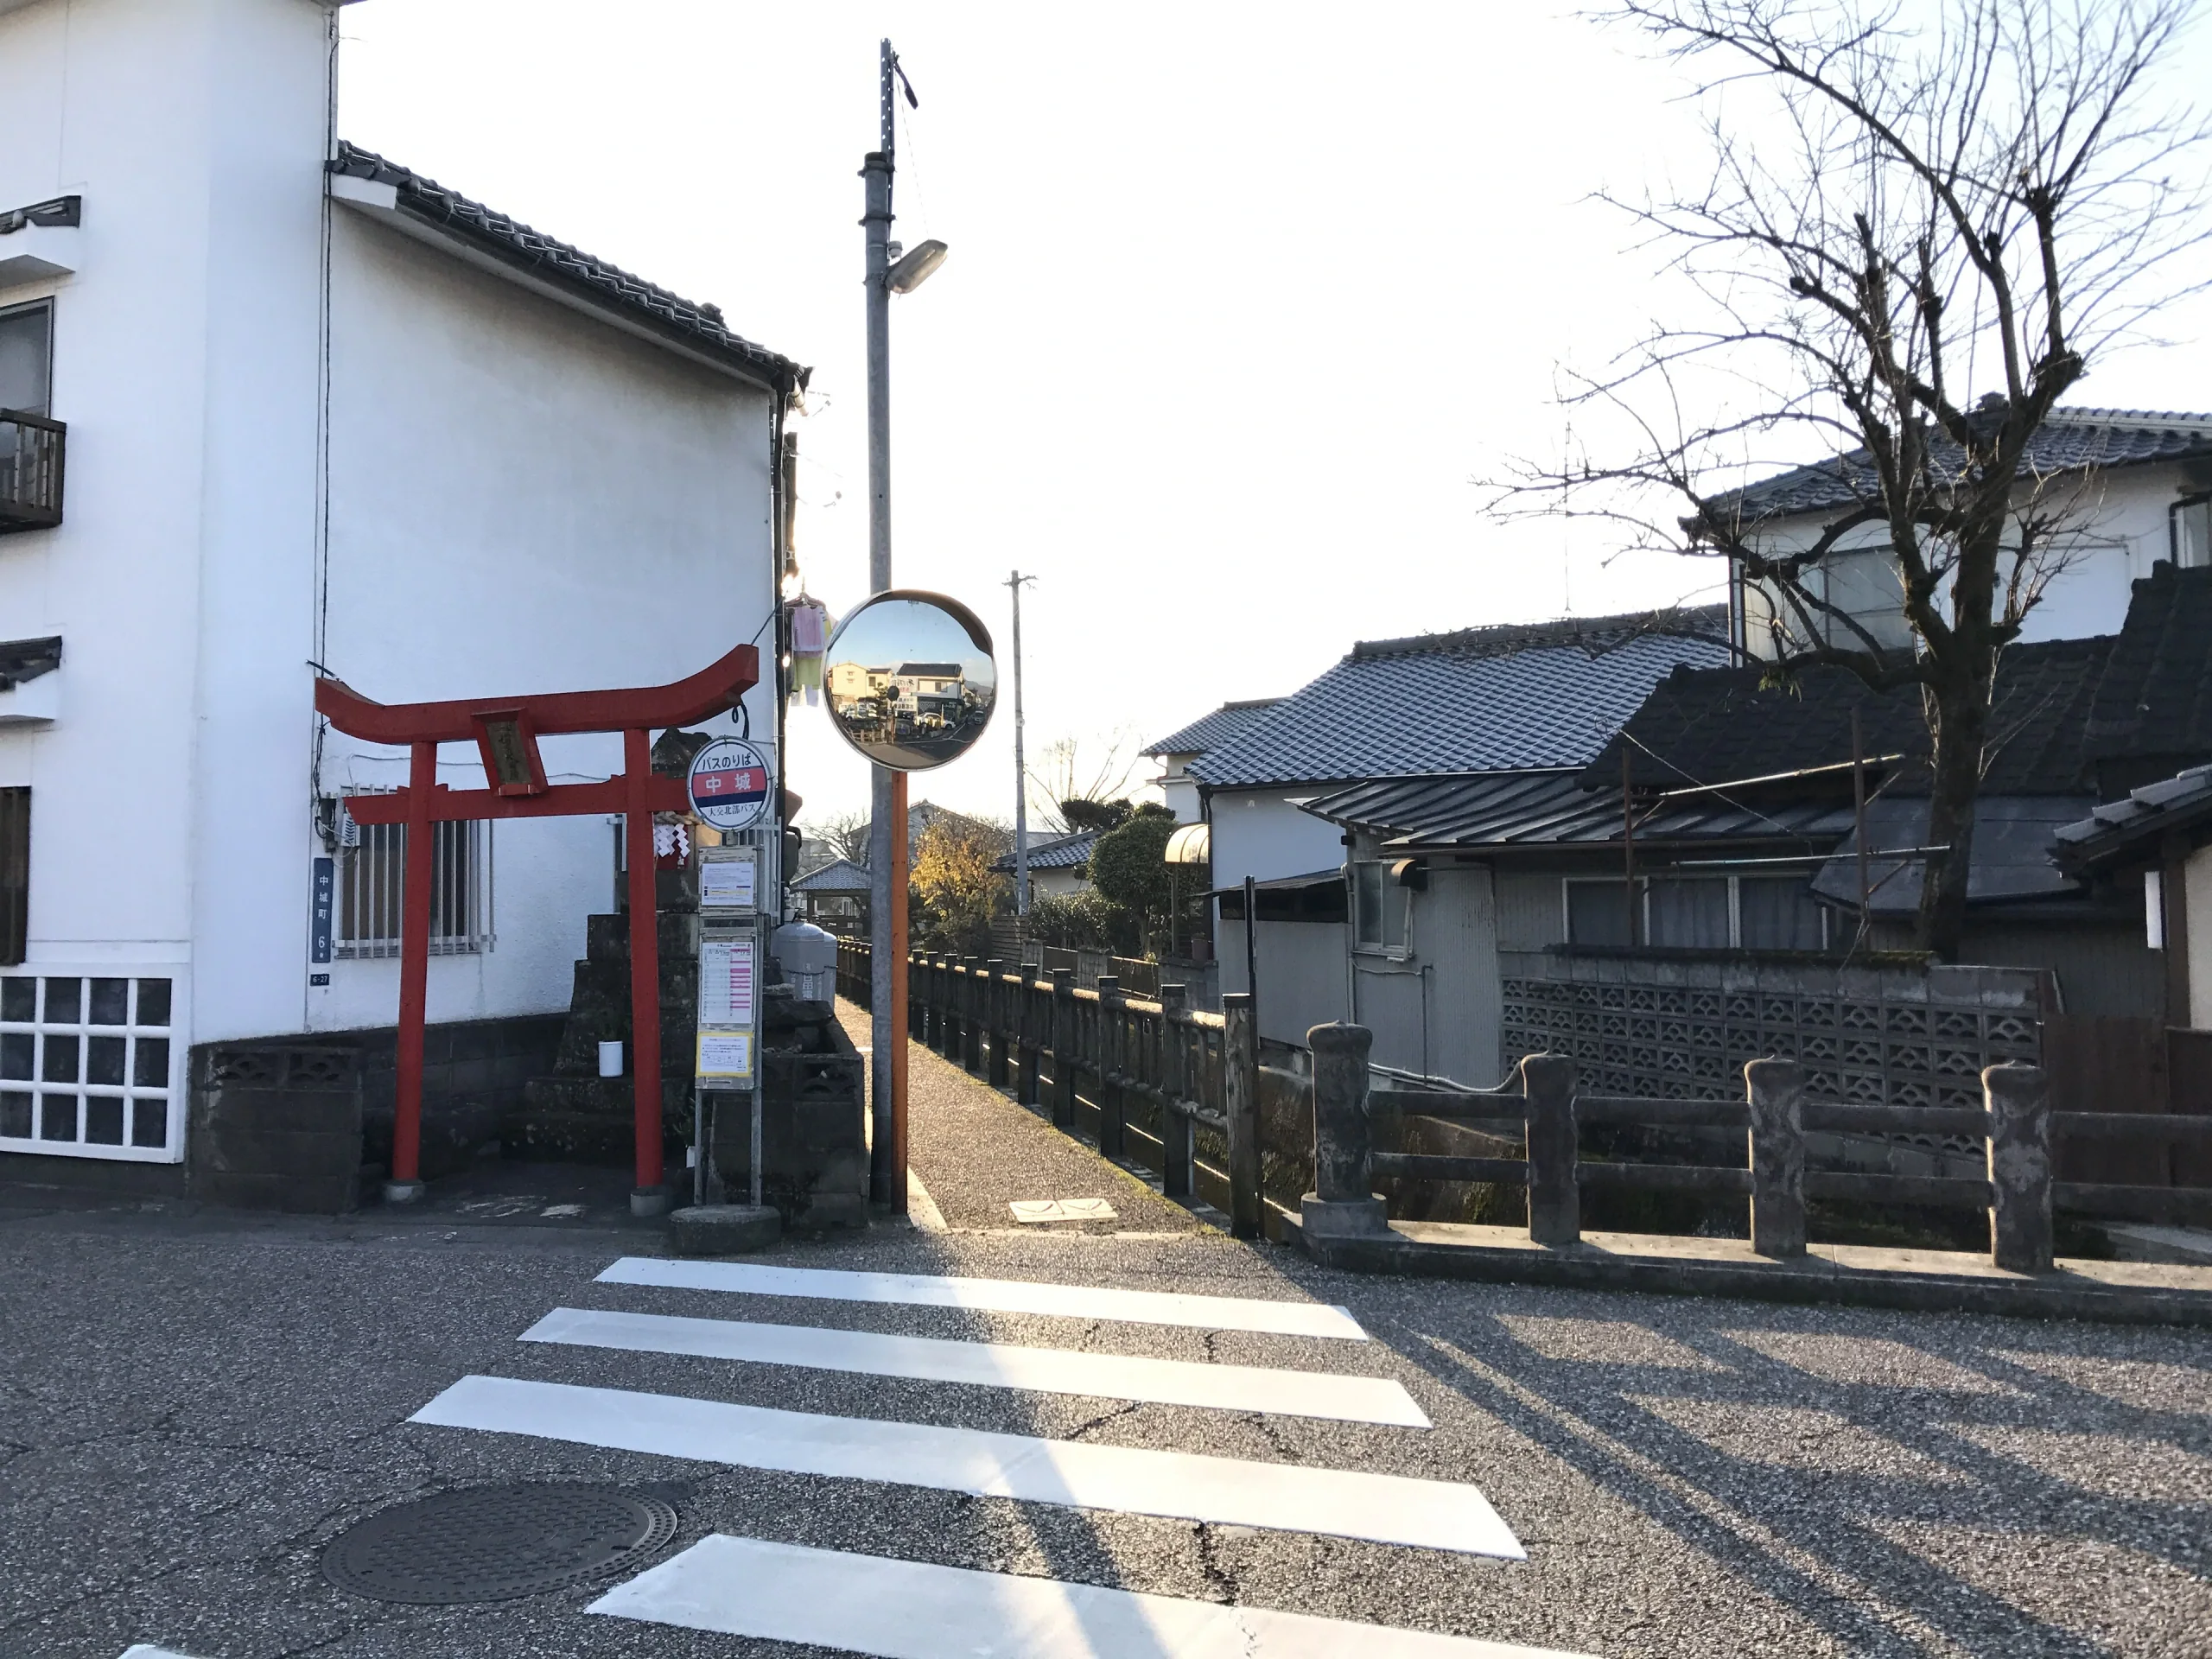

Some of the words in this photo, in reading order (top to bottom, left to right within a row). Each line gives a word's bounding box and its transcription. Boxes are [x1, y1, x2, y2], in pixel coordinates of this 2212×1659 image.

[702, 753, 752, 770] バスのりば
[705, 772, 751, 792] 中城
[709, 804, 755, 817] 大交北部バス
[319, 875, 328, 919] 中城町
